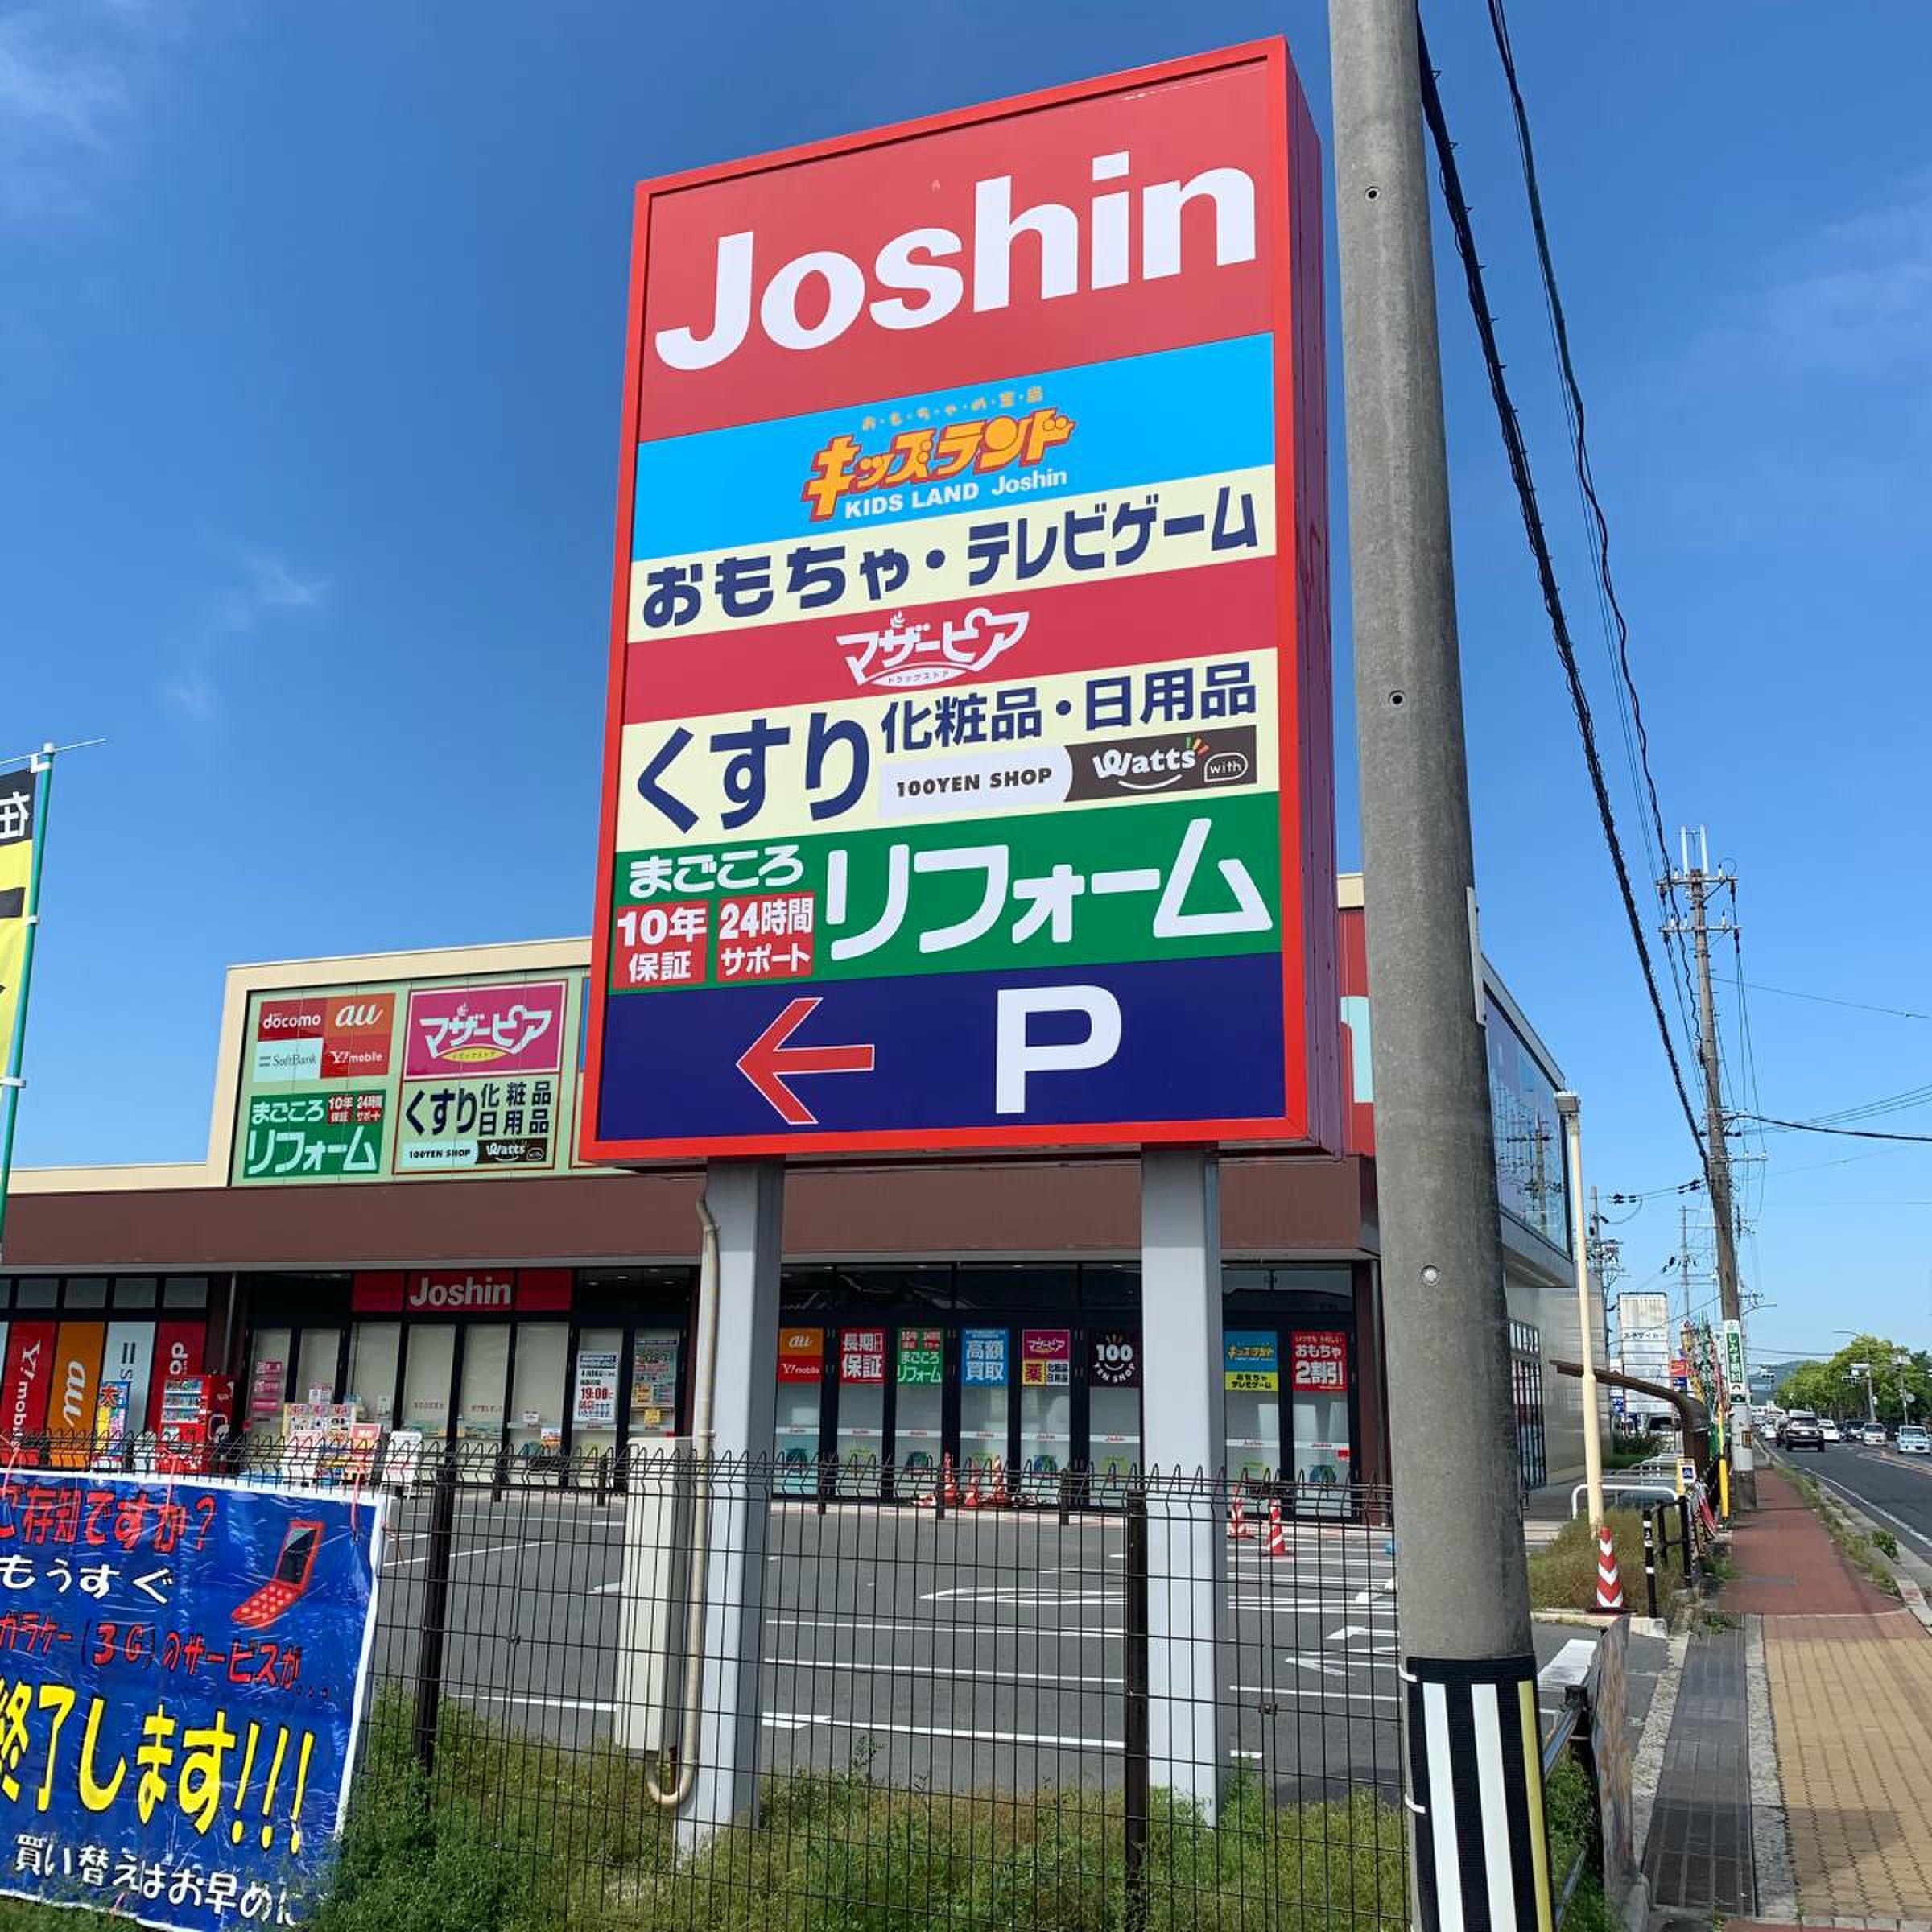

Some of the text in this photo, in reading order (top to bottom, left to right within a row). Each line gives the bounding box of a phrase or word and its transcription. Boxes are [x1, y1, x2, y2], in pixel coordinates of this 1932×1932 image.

[655, 151, 1256, 370] Joshin
[801, 407, 1076, 522] キッズランド
[844, 469, 1067, 519] KIDS LAND Joshin
[836, 608, 1030, 685] マザーピア
[637, 712, 870, 834] くすり
[1092, 746, 1243, 779] Watts with
[896, 768, 1052, 797] 100YEN SHOP
[629, 845, 803, 898] まごころ
[825, 818, 1274, 961] リフォーム
[617, 907, 707, 947] 10年
[719, 898, 814, 940] 24時間
[629, 950, 691, 983] 保証
[720, 943, 810, 976] サポート
[262, 1012, 322, 1030] docomo
[335, 1004, 382, 1028] au
[420, 1003, 552, 1059] マザーピア
[273, 1052, 316, 1067] SoftBank
[996, 985, 1121, 1114] P
[481, 1081, 551, 1108] 化粧品
[252, 1100, 324, 1125] まごころ
[406, 1089, 477, 1136] くすり
[479, 1109, 549, 1137] 日用品
[248, 1125, 378, 1174] リフォーム
[410, 1276, 511, 1307] Joshin
[789, 1335, 812, 1348] au
[901, 1352, 940, 1364] まごころ
[1096, 1344, 1133, 1362] 100
[1295, 1344, 1342, 1359] おもちゃ
[842, 1353, 883, 1378] 保証
[897, 1364, 942, 1383] リフォーム
[965, 1360, 1004, 1381] 買取
[64, 1360, 86, 1427] au
[0, 1554, 173, 1604] もうすぐ
